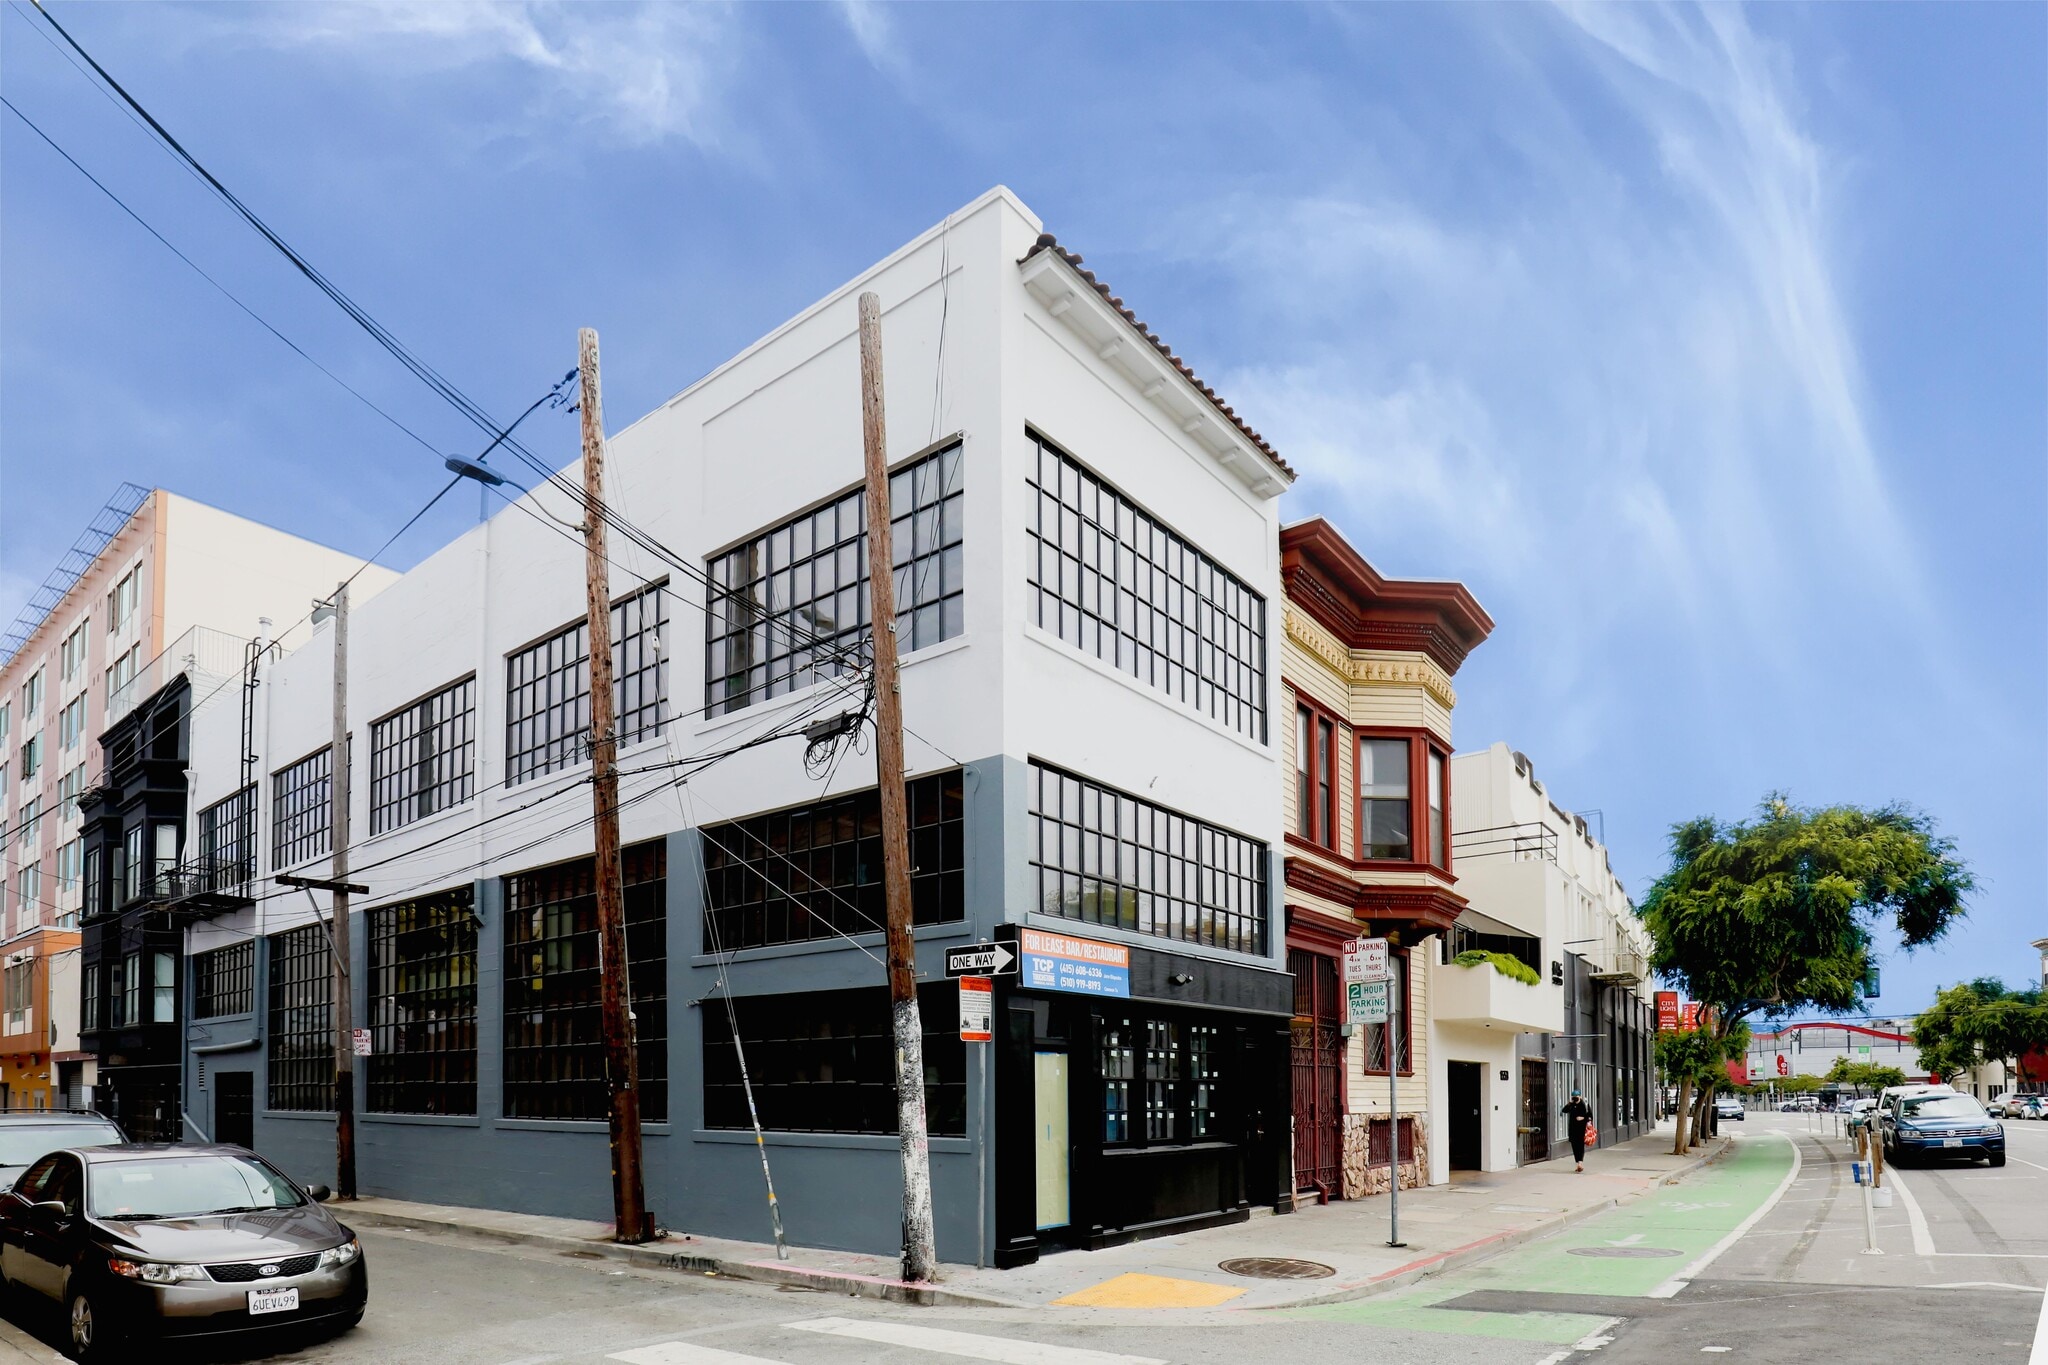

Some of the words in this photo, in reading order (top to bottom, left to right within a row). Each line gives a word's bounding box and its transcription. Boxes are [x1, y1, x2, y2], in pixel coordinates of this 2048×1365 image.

[1025, 934, 1040, 950] FOR
[1042, 936, 1065, 954] LEASE
[1066, 940, 1126, 963] BAR/RESTAURANT
[1345, 942, 1356, 953] NO
[1358, 942, 1384, 951] PARKING
[953, 956, 971, 968] ONE
[975, 953, 995, 966] WAY
[1032, 957, 1054, 972] TCP
[1060, 963, 1074, 975] (415)
[1061, 977, 1075, 988] (510)
[1350, 985, 1360, 998] 2
[1364, 985, 1384, 994] HOUR
[1351, 998, 1385, 1008] PARKING
[261, 1266, 280, 1274] KIA
[253, 1296, 296, 1311] 6UEV499
